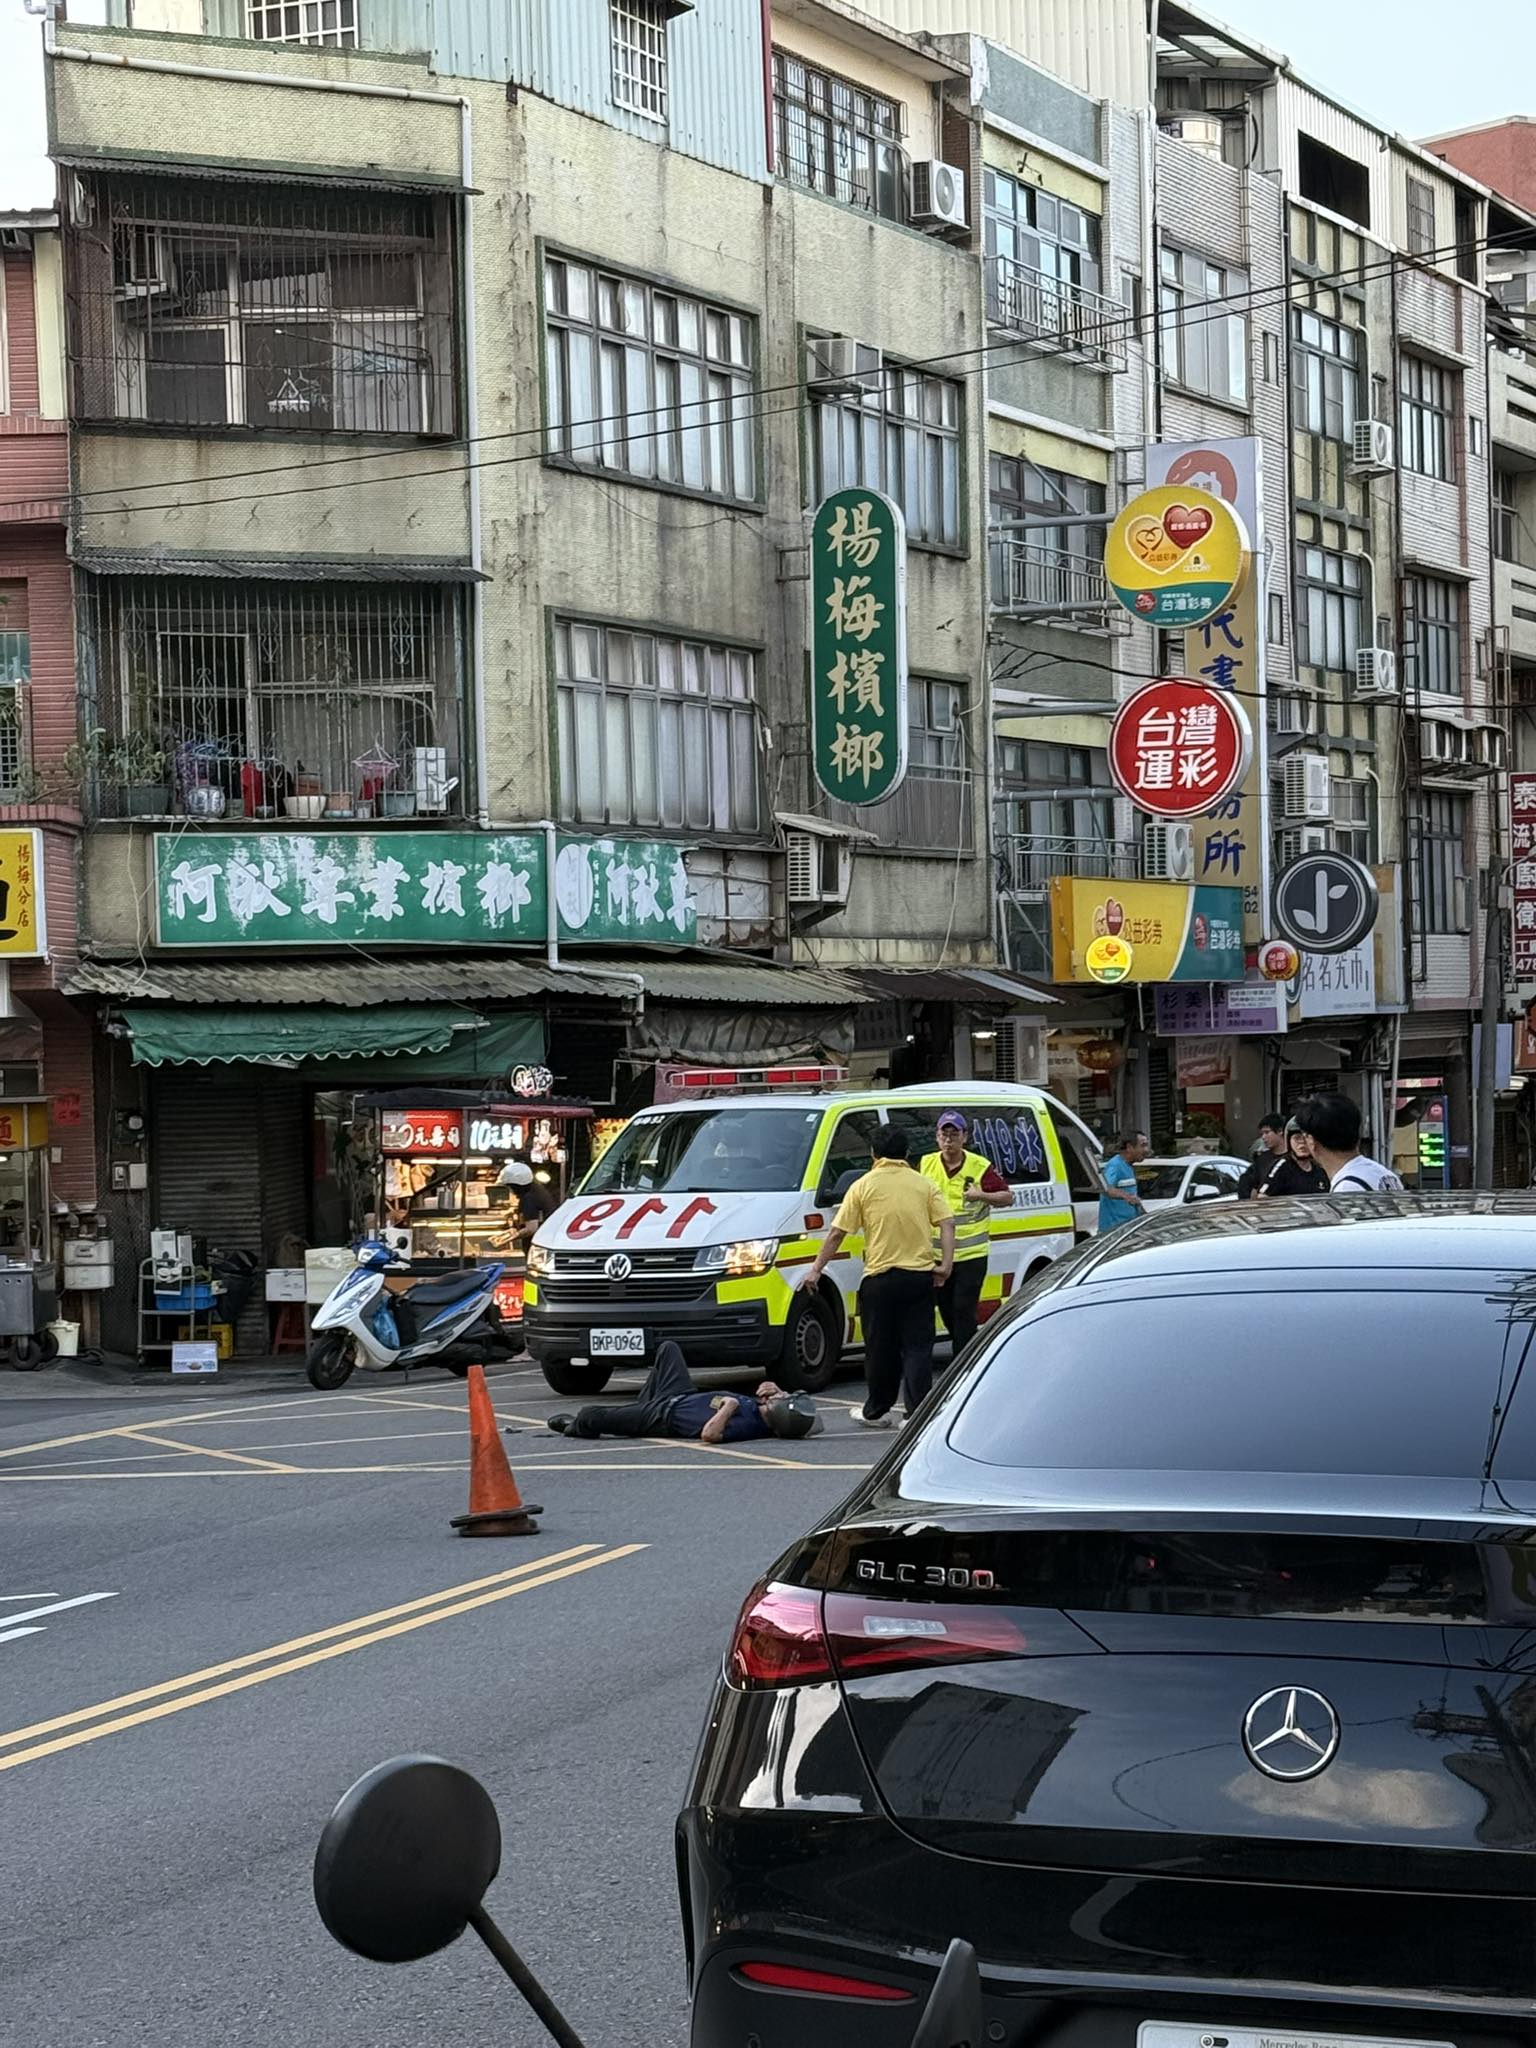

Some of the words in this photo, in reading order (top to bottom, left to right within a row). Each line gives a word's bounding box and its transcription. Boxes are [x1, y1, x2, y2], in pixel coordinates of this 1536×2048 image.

[825, 501, 885, 789] 楊梅檳榔
[1136, 703, 1217, 748] 台灣
[1134, 747, 1218, 789] 運彩
[1513, 822, 1536, 849] 流
[16, 845, 32, 928] 楊梅分店
[390, 1124, 460, 1149] 0元壽司
[592, 1335, 643, 1351] BKP-0962
[857, 1559, 917, 1584] GLC
[923, 1566, 994, 1589] 300
